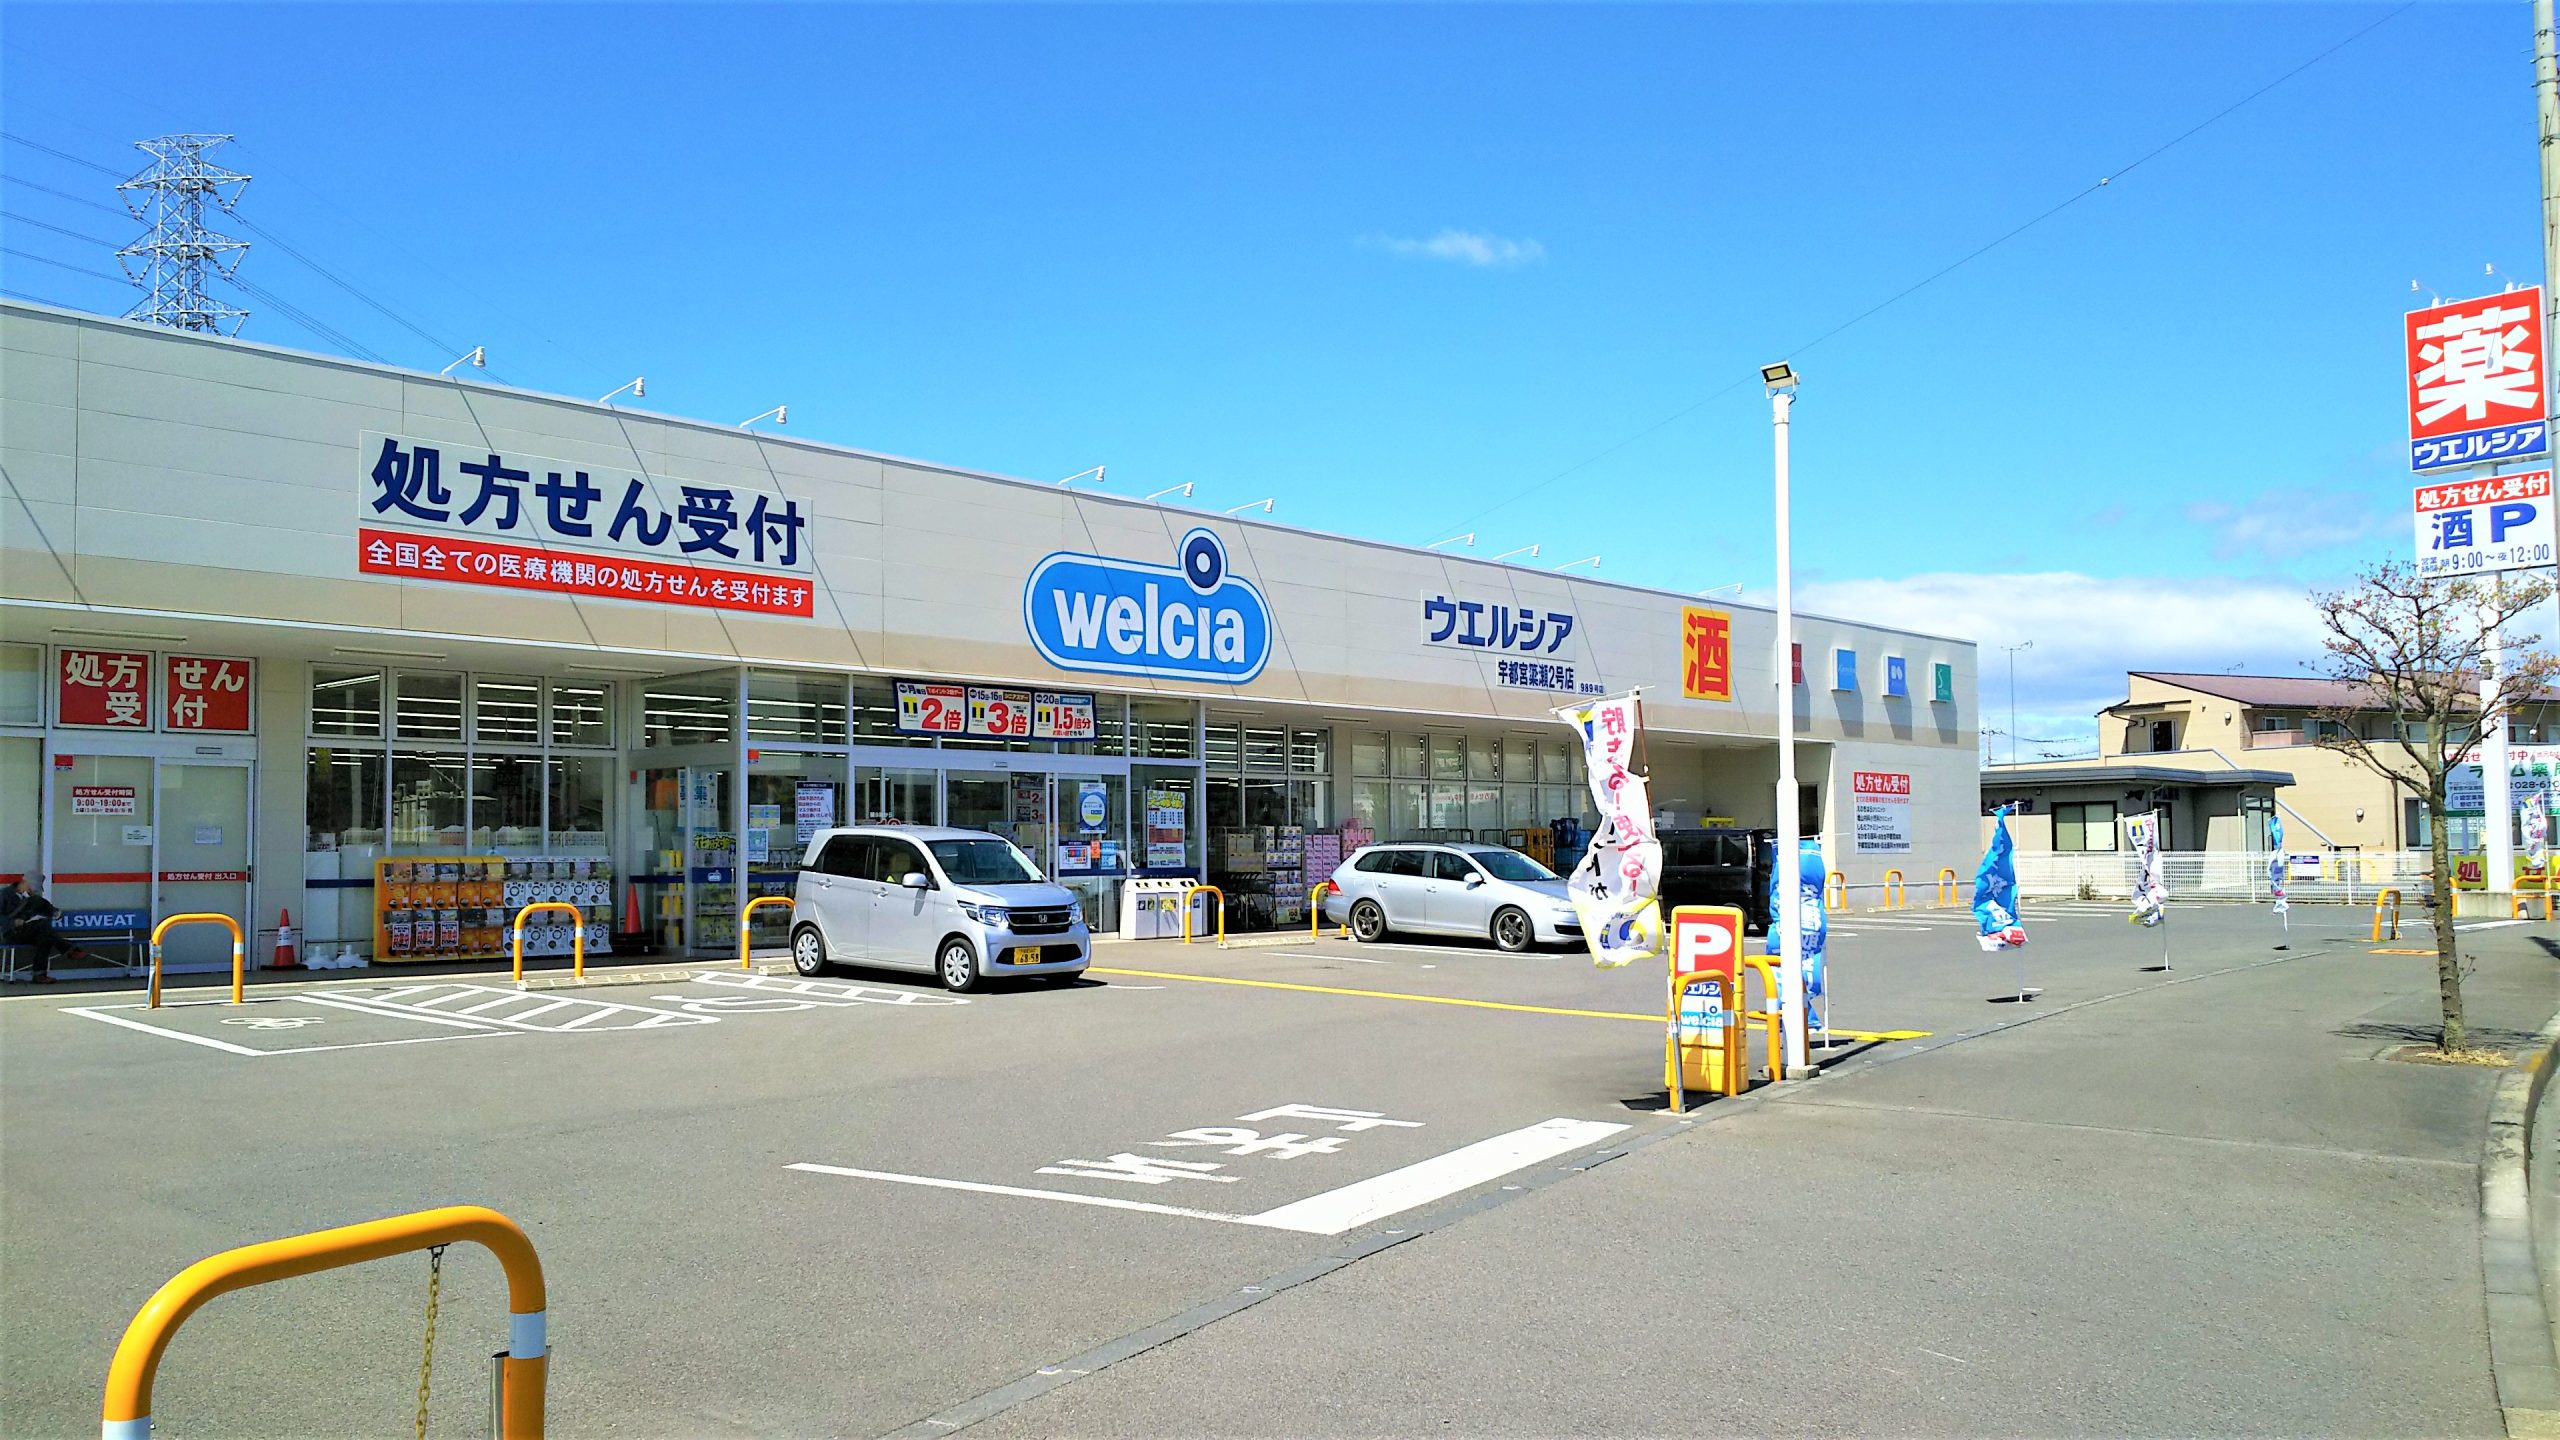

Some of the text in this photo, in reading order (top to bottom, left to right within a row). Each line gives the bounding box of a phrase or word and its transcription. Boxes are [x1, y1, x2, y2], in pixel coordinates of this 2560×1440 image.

[2414, 305, 2540, 426] 薬
[2414, 426, 2543, 466] ウエルシア
[371, 437, 805, 566] 処方せん受付
[2419, 474, 2548, 510] 処方せん受付
[2432, 503, 2537, 550] 酒 P
[367, 540, 808, 608] 全国全ての医療機関の処方せんを受付ます
[1052, 537, 1246, 664] welcia
[1424, 596, 1573, 653] ウエルシア
[1686, 613, 1729, 695] 酒
[921, 698, 962, 730] 2倍
[987, 702, 1027, 734] 3倍
[1856, 774, 1908, 793] 処方せん受付
[2457, 861, 2482, 882] 処
[74, 914, 136, 927] SWEAT
[1678, 922, 1732, 972] P
